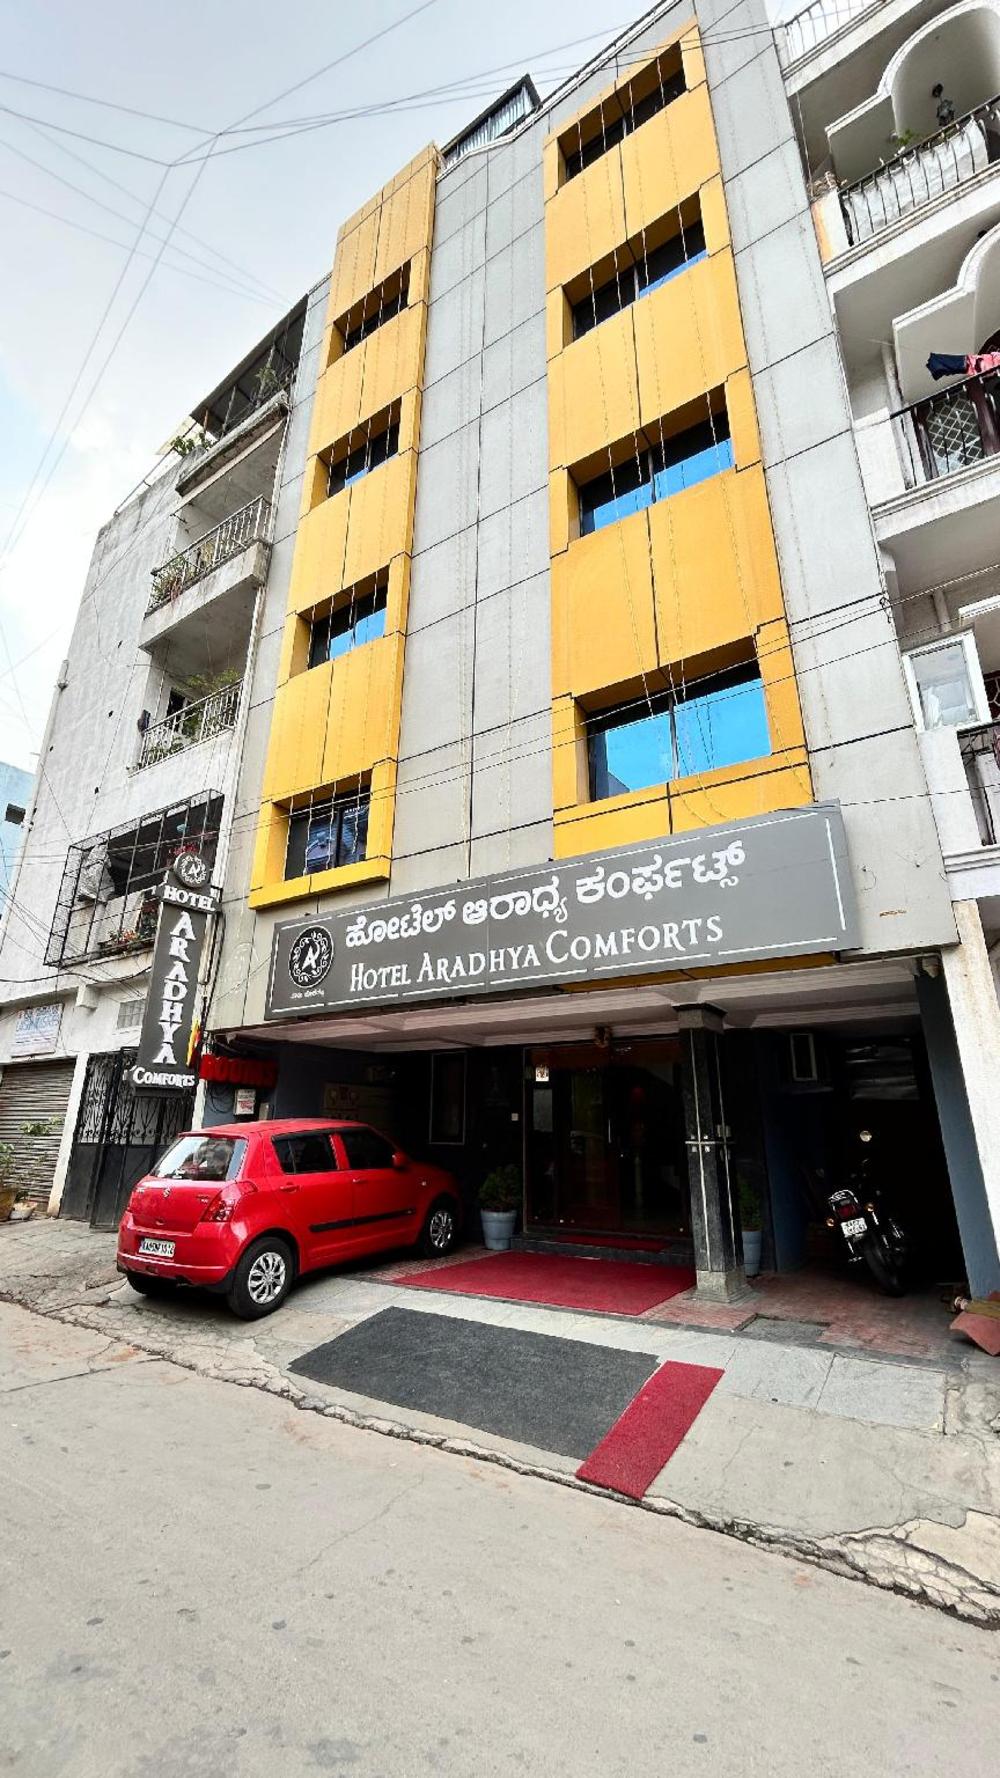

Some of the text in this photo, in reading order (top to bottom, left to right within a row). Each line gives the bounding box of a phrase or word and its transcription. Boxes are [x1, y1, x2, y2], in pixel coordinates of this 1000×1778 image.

[163, 885, 216, 912] HOTEL
[345, 899, 456, 948] ಹೋಟೆಲ್
[152, 910, 197, 1065] ARADHYA
[133, 1066, 195, 1088] COMFORTS
